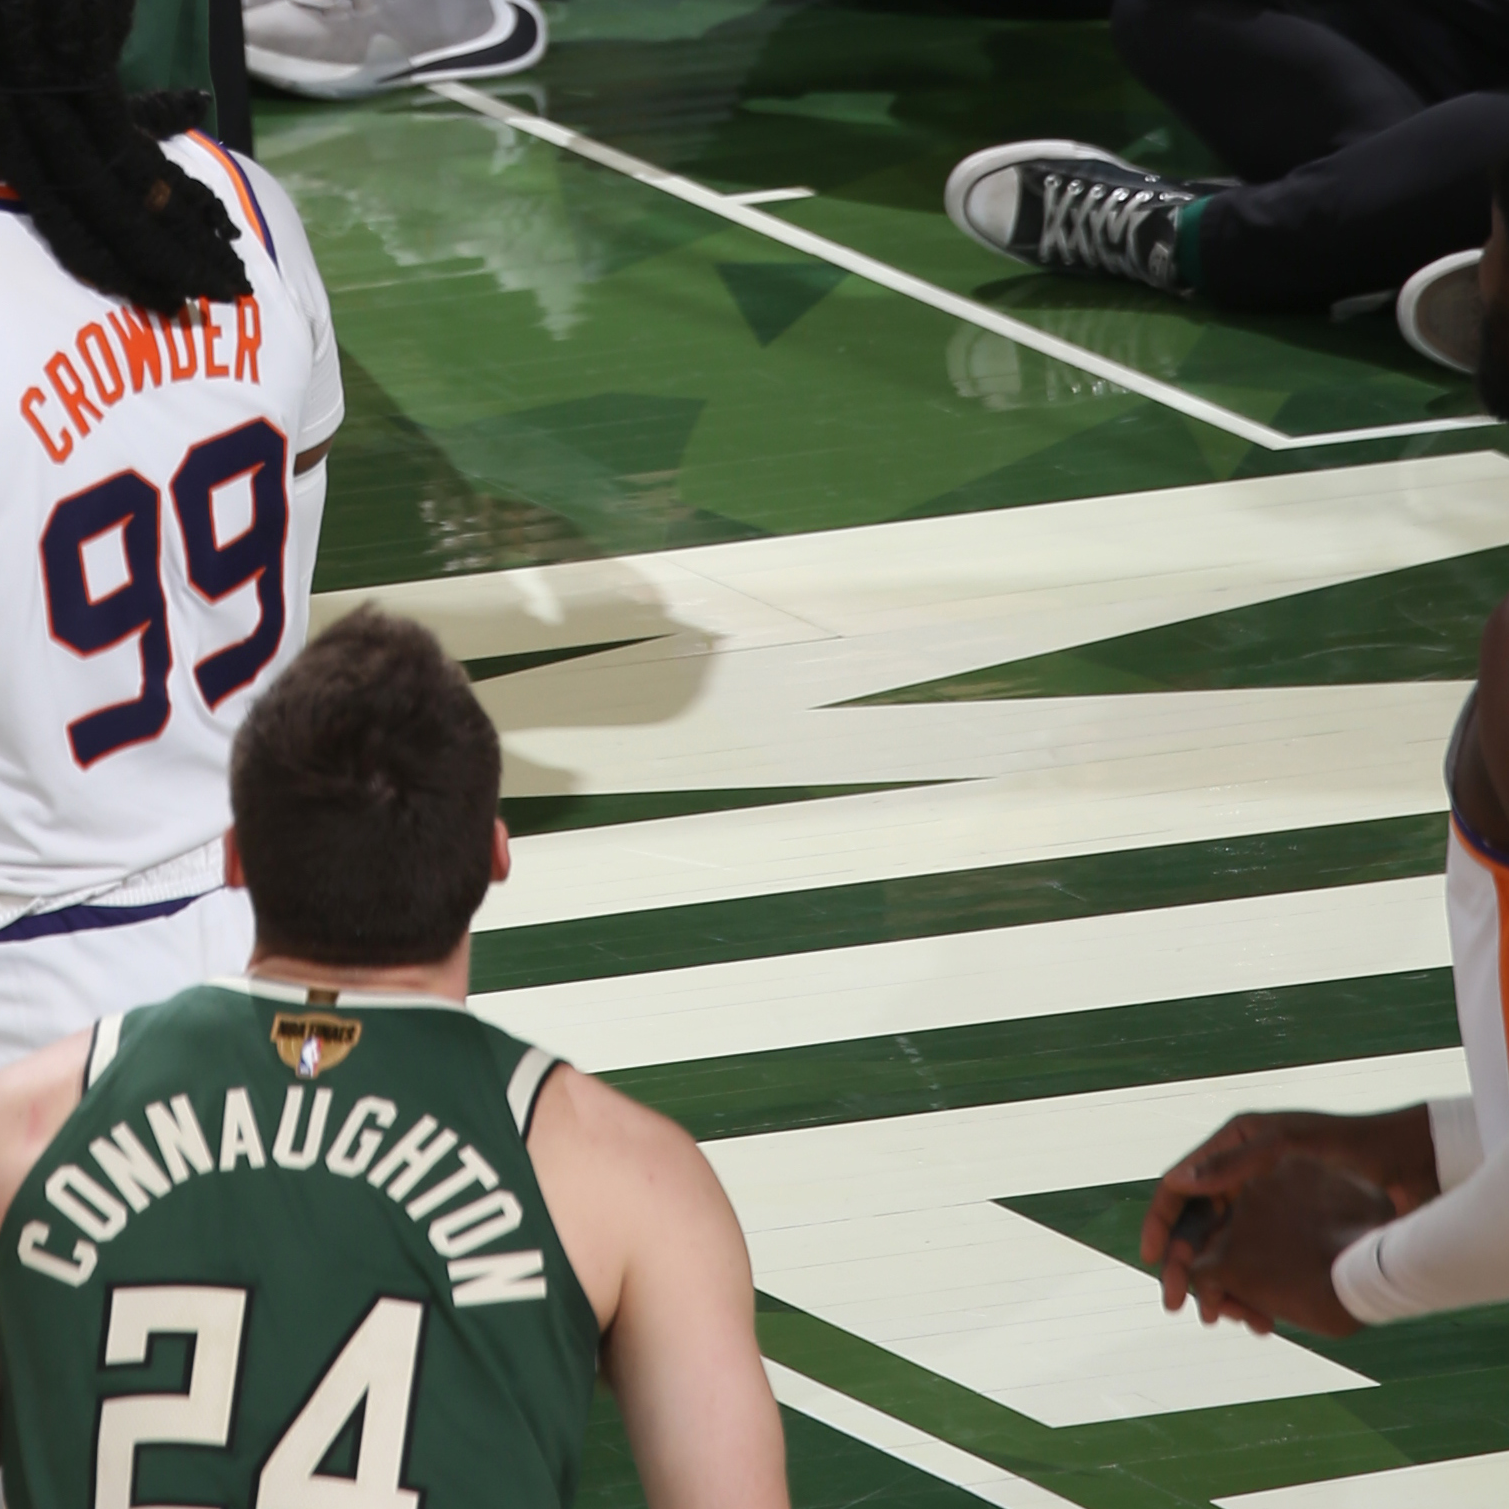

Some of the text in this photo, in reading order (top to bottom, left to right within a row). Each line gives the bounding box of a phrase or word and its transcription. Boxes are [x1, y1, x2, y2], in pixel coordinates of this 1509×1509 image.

[19, 293, 262, 465] CROWDER
[39, 415, 289, 772] 99
[17, 1085, 547, 1308] CONNAUGHTON
[93, 1284, 427, 1509] 24
